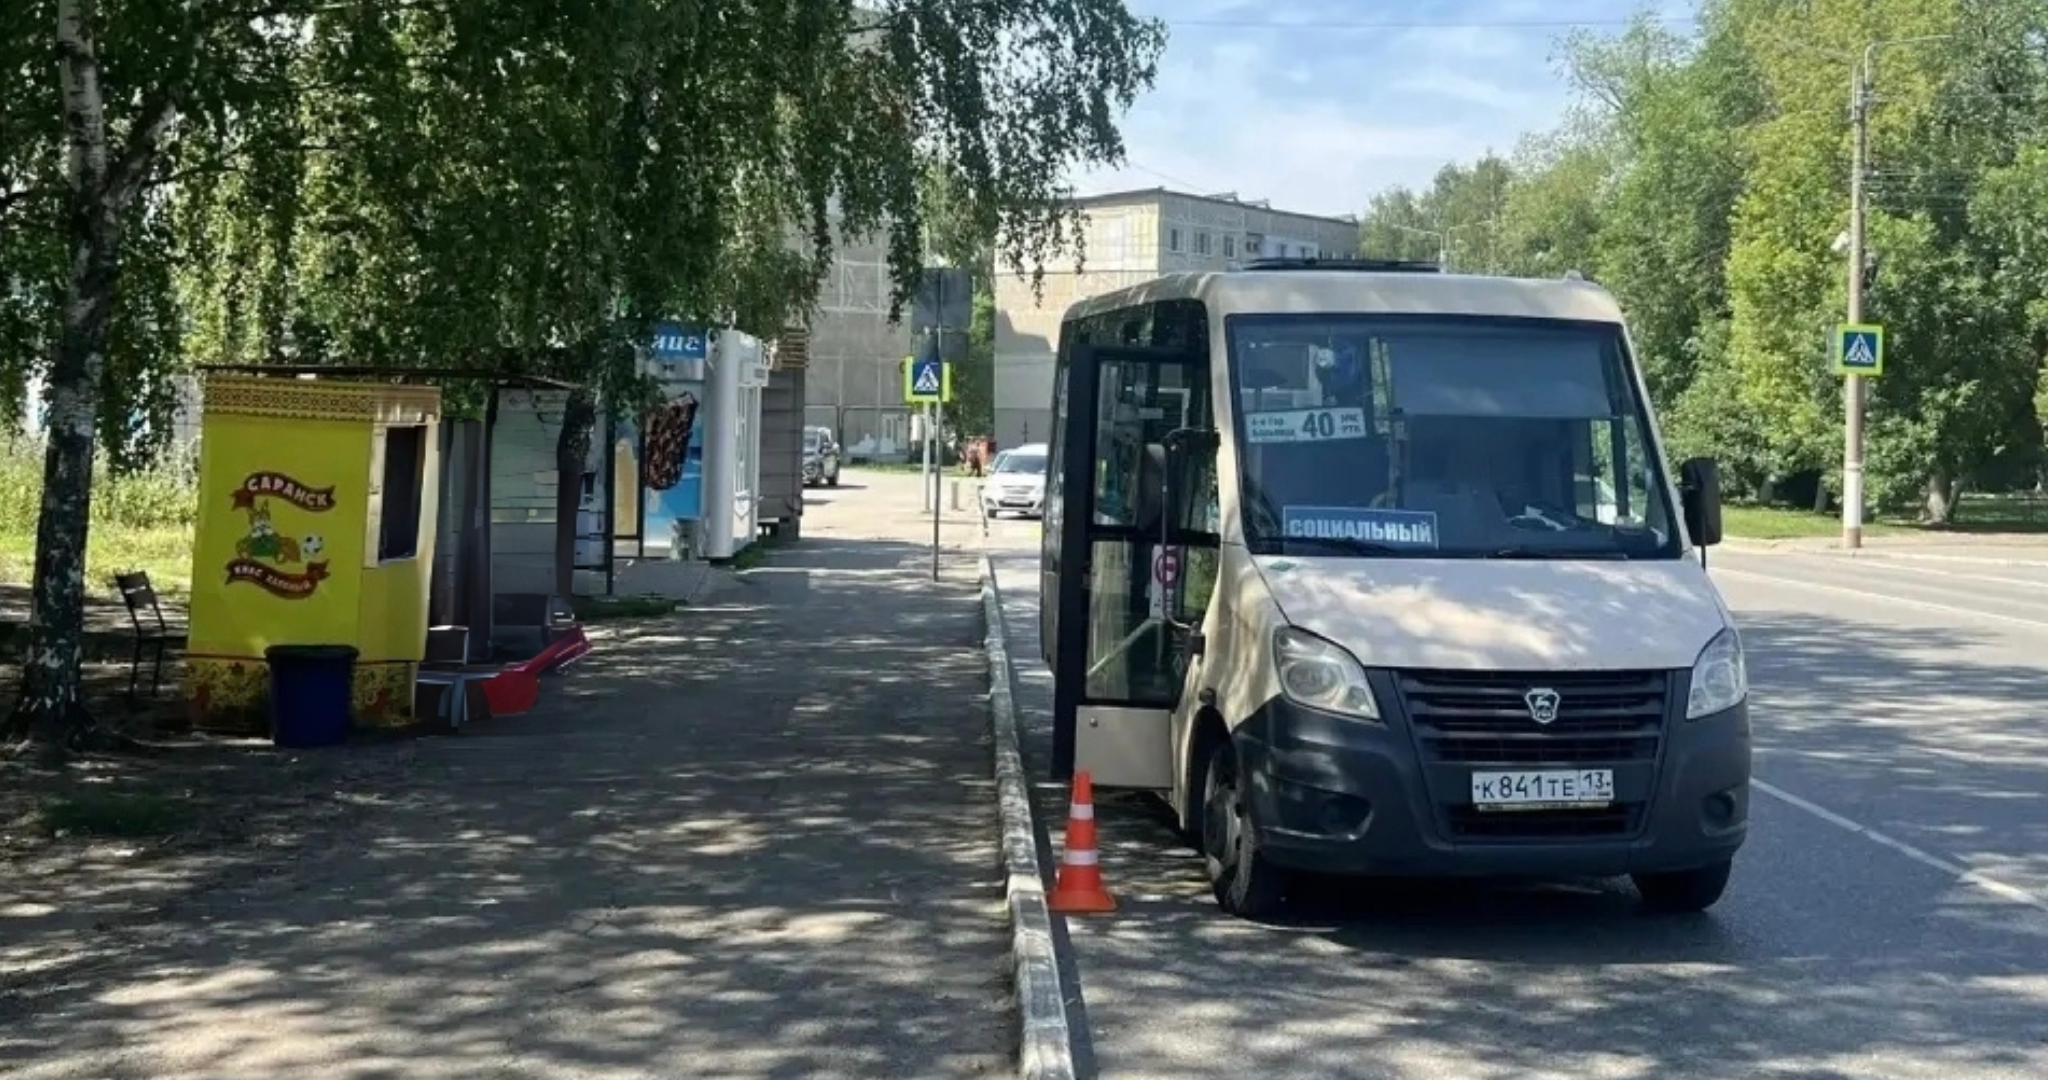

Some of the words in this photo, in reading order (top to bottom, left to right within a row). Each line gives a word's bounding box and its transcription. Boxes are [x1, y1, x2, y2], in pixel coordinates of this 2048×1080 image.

[1302, 411, 1335, 438] 40
[247, 475, 328, 506] САРАНСК
[1288, 519, 1432, 543] СОЦИАЛЬНЫЙ
[1482, 774, 1576, 800] К841ТЕ
[1582, 772, 1606, 791] 13
